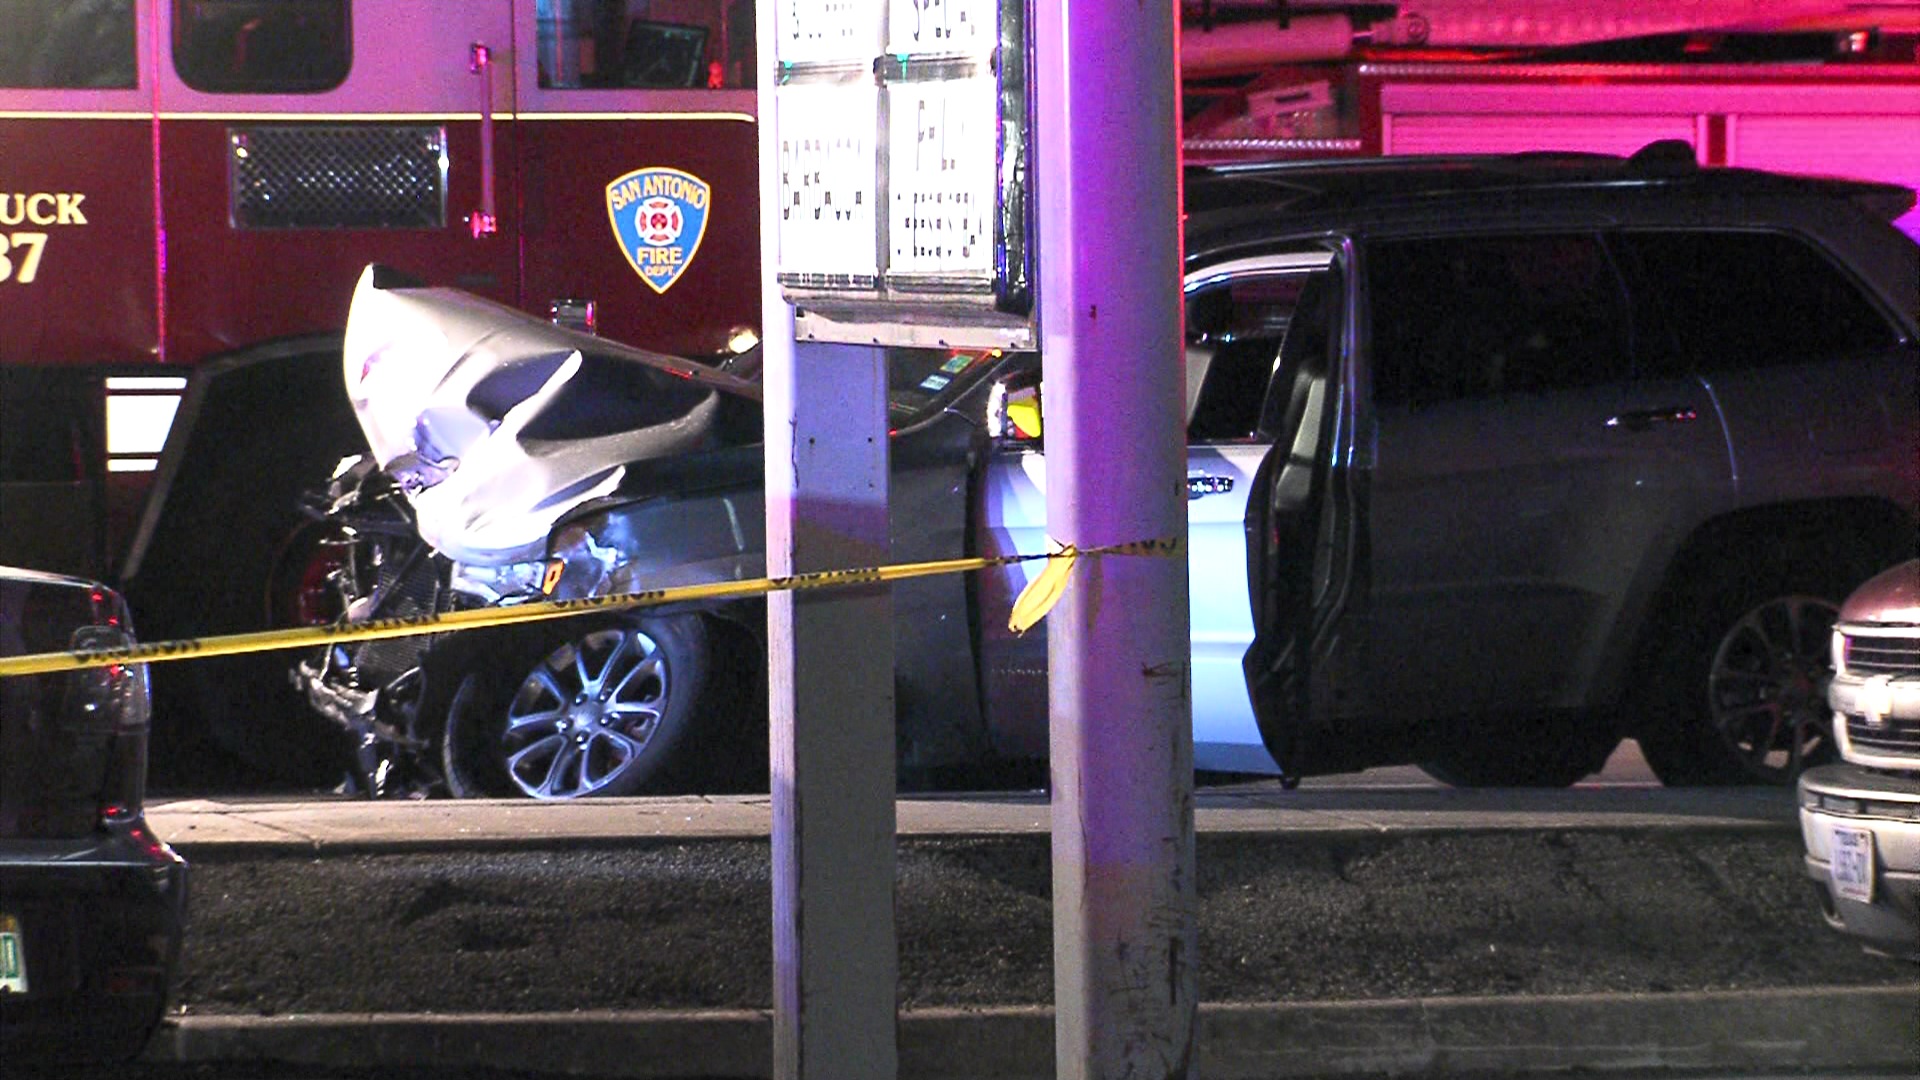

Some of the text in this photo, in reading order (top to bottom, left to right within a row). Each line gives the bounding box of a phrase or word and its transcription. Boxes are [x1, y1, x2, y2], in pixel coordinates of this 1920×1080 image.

[610, 175, 707, 210] SAN ANTONIO
[637, 247, 684, 265] FIRE
